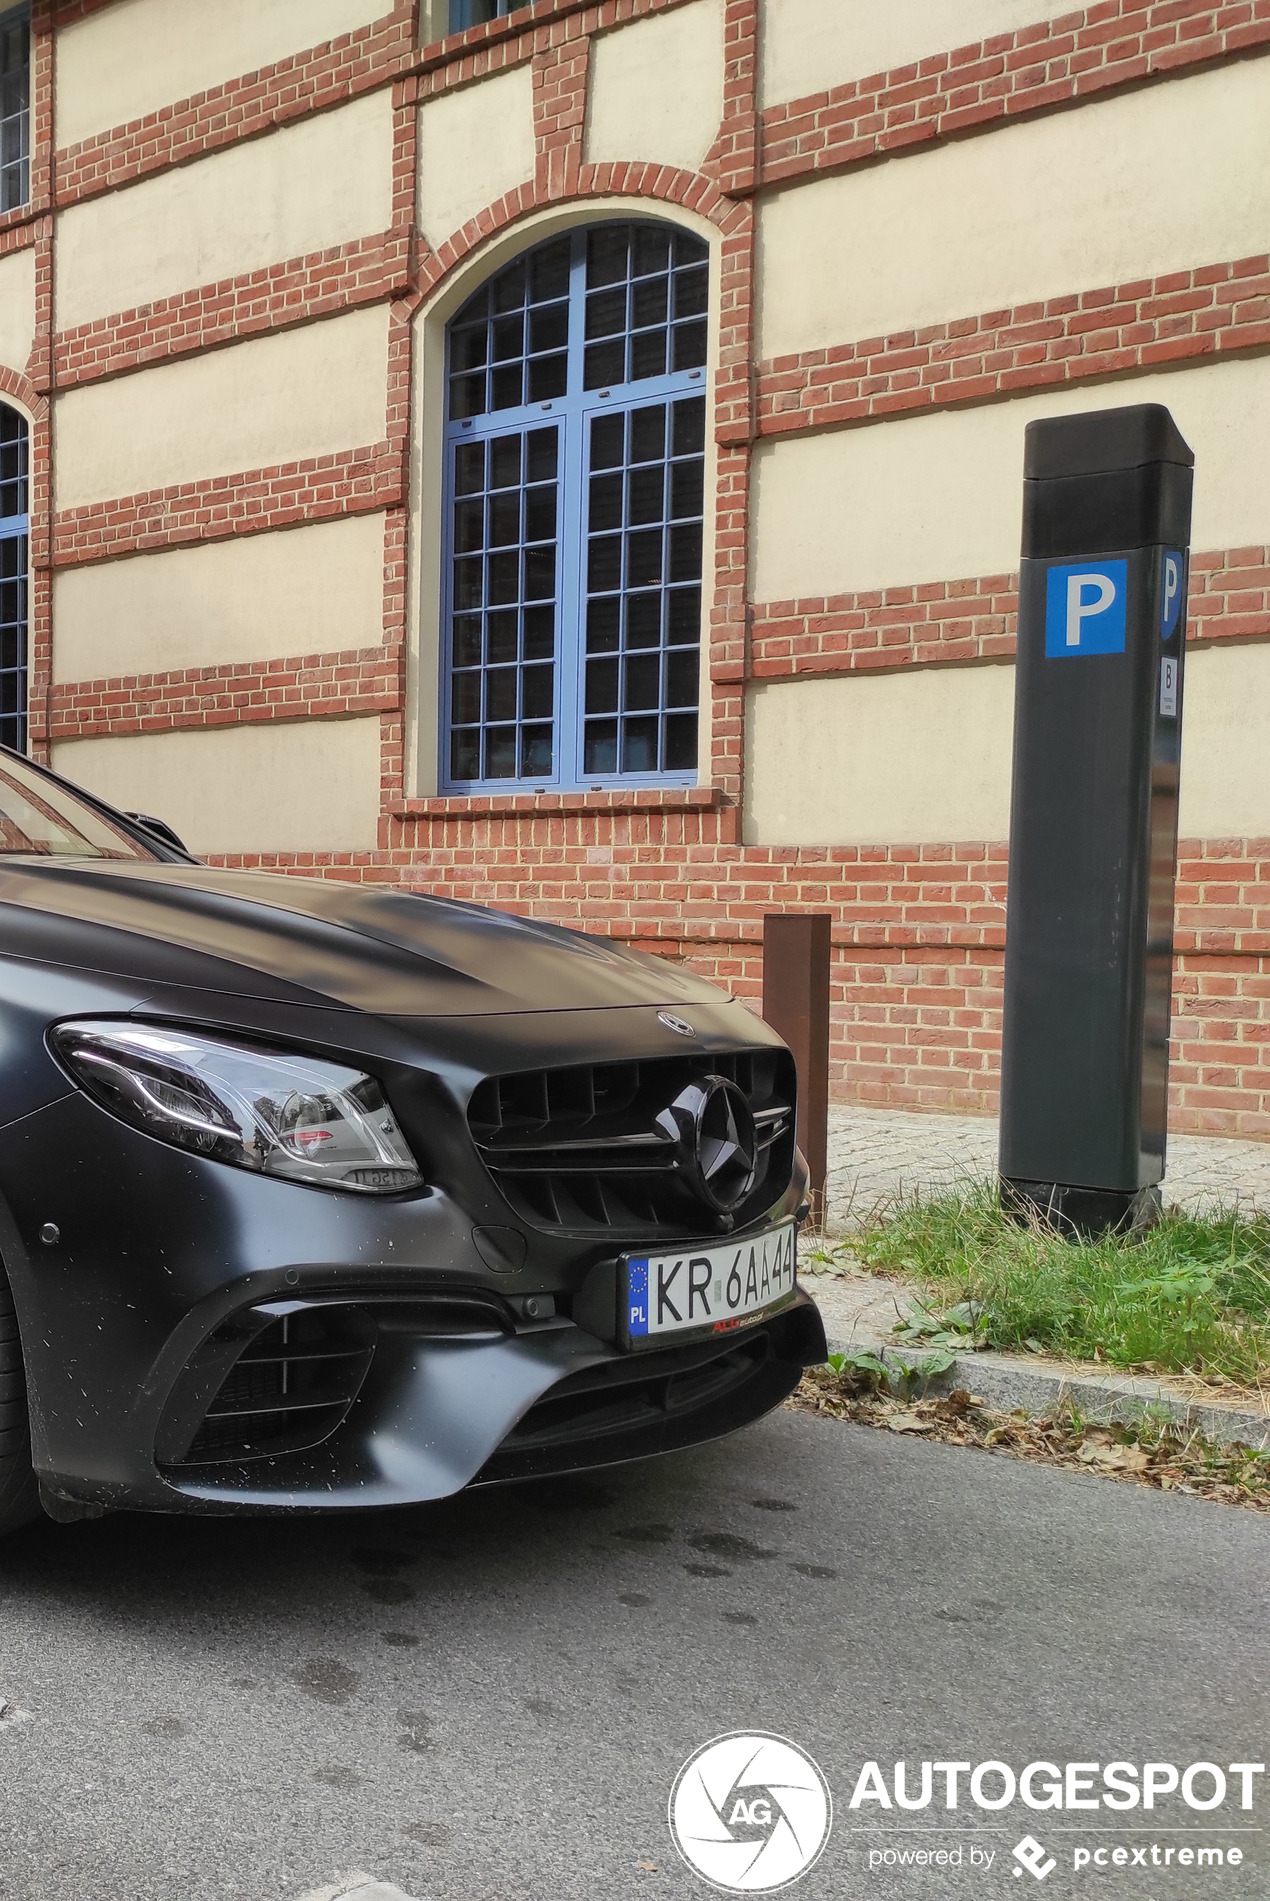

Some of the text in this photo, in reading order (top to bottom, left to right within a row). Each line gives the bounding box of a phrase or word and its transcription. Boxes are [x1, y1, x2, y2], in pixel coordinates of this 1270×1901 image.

[1066, 573, 1115, 646] P
[1164, 557, 1177, 621] P
[1165, 663, 1172, 689] B
[657, 1228, 792, 1325] KR 6AA44
[630, 1307, 646, 1324] PL
